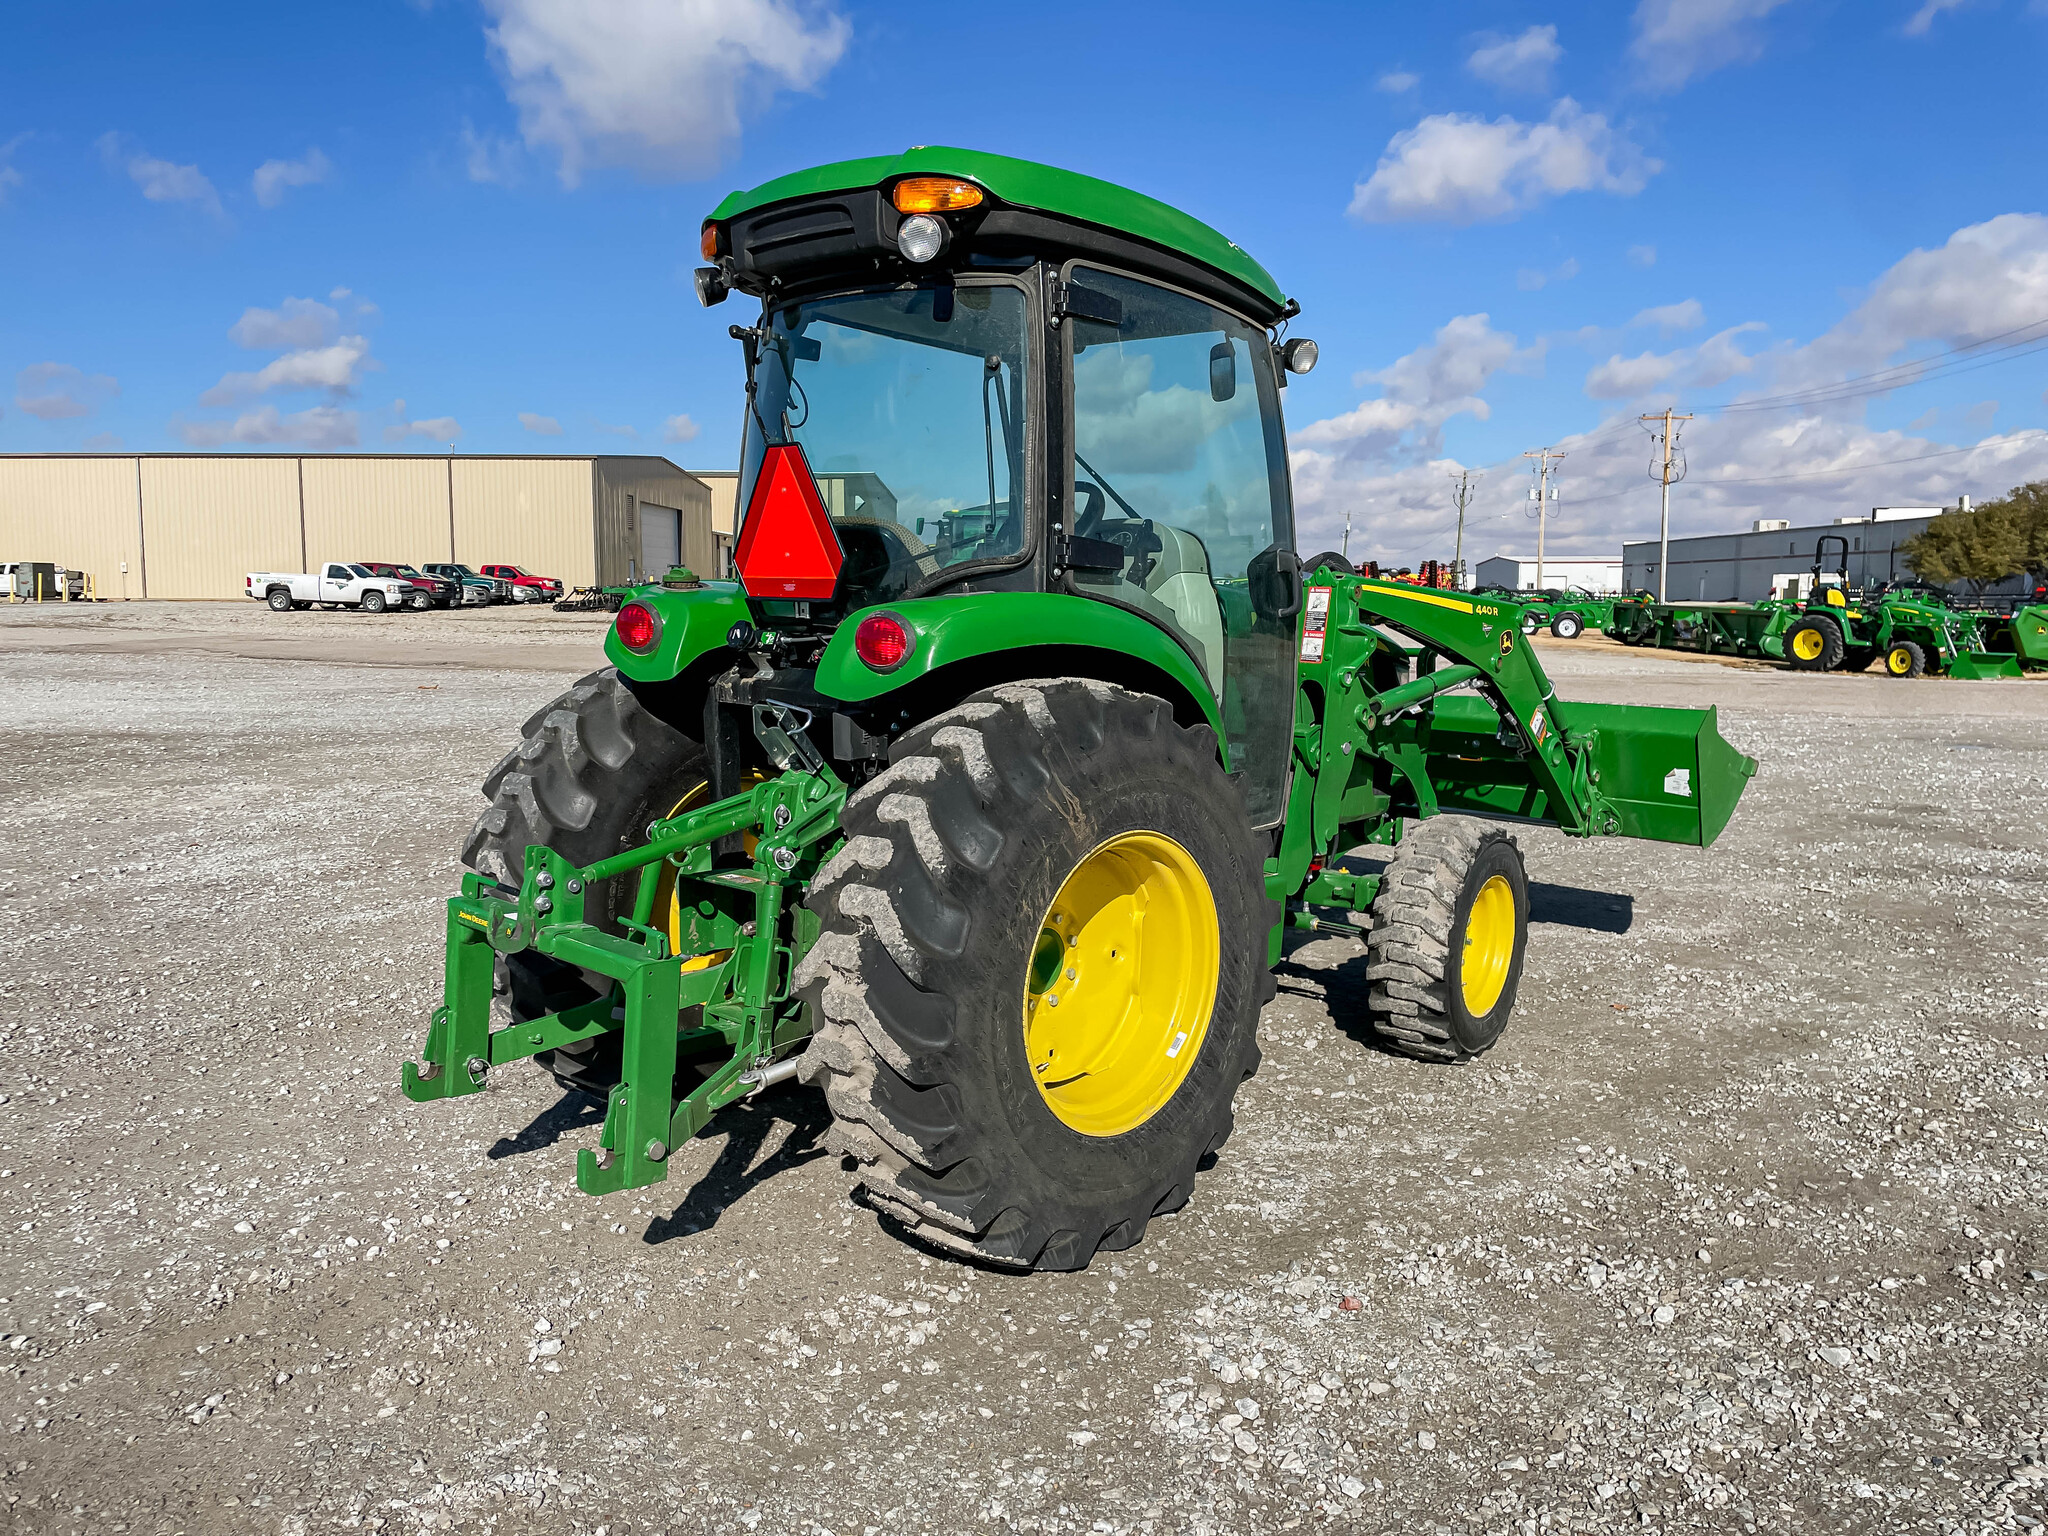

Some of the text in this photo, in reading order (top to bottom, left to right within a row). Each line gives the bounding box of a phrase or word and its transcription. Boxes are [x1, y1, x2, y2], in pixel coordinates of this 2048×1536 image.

[1476, 604, 1498, 616] 440R
[458, 911, 488, 927] JOHN DEERE
